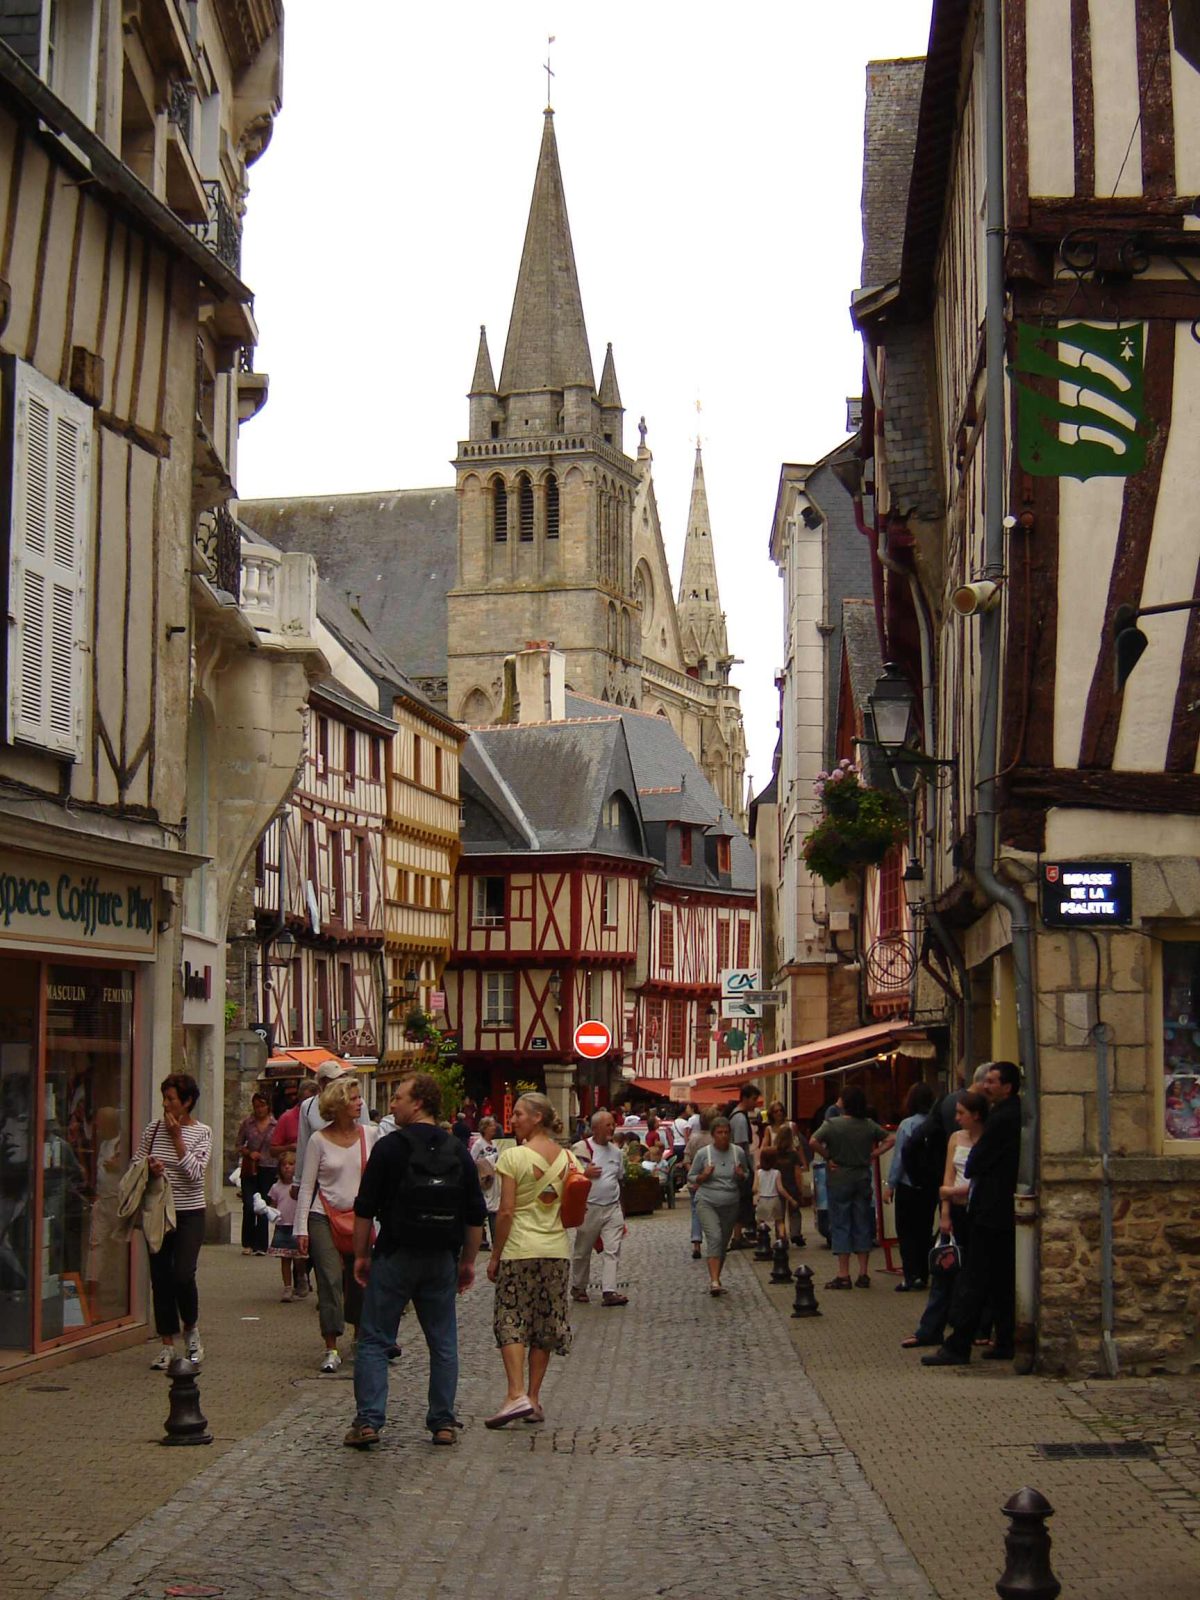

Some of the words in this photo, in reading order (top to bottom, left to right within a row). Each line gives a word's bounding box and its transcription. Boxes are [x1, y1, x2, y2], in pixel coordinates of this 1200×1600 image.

[1063, 873, 1112, 885] IMPASSE
[1070, 887, 1086, 899] DE
[1089, 887, 1104, 899] LA
[57, 874, 123, 936] Coiffure
[126, 885, 153, 935] Plus
[47, 984, 86, 1001] MASCULIN
[103, 987, 133, 1003] FEMININ
